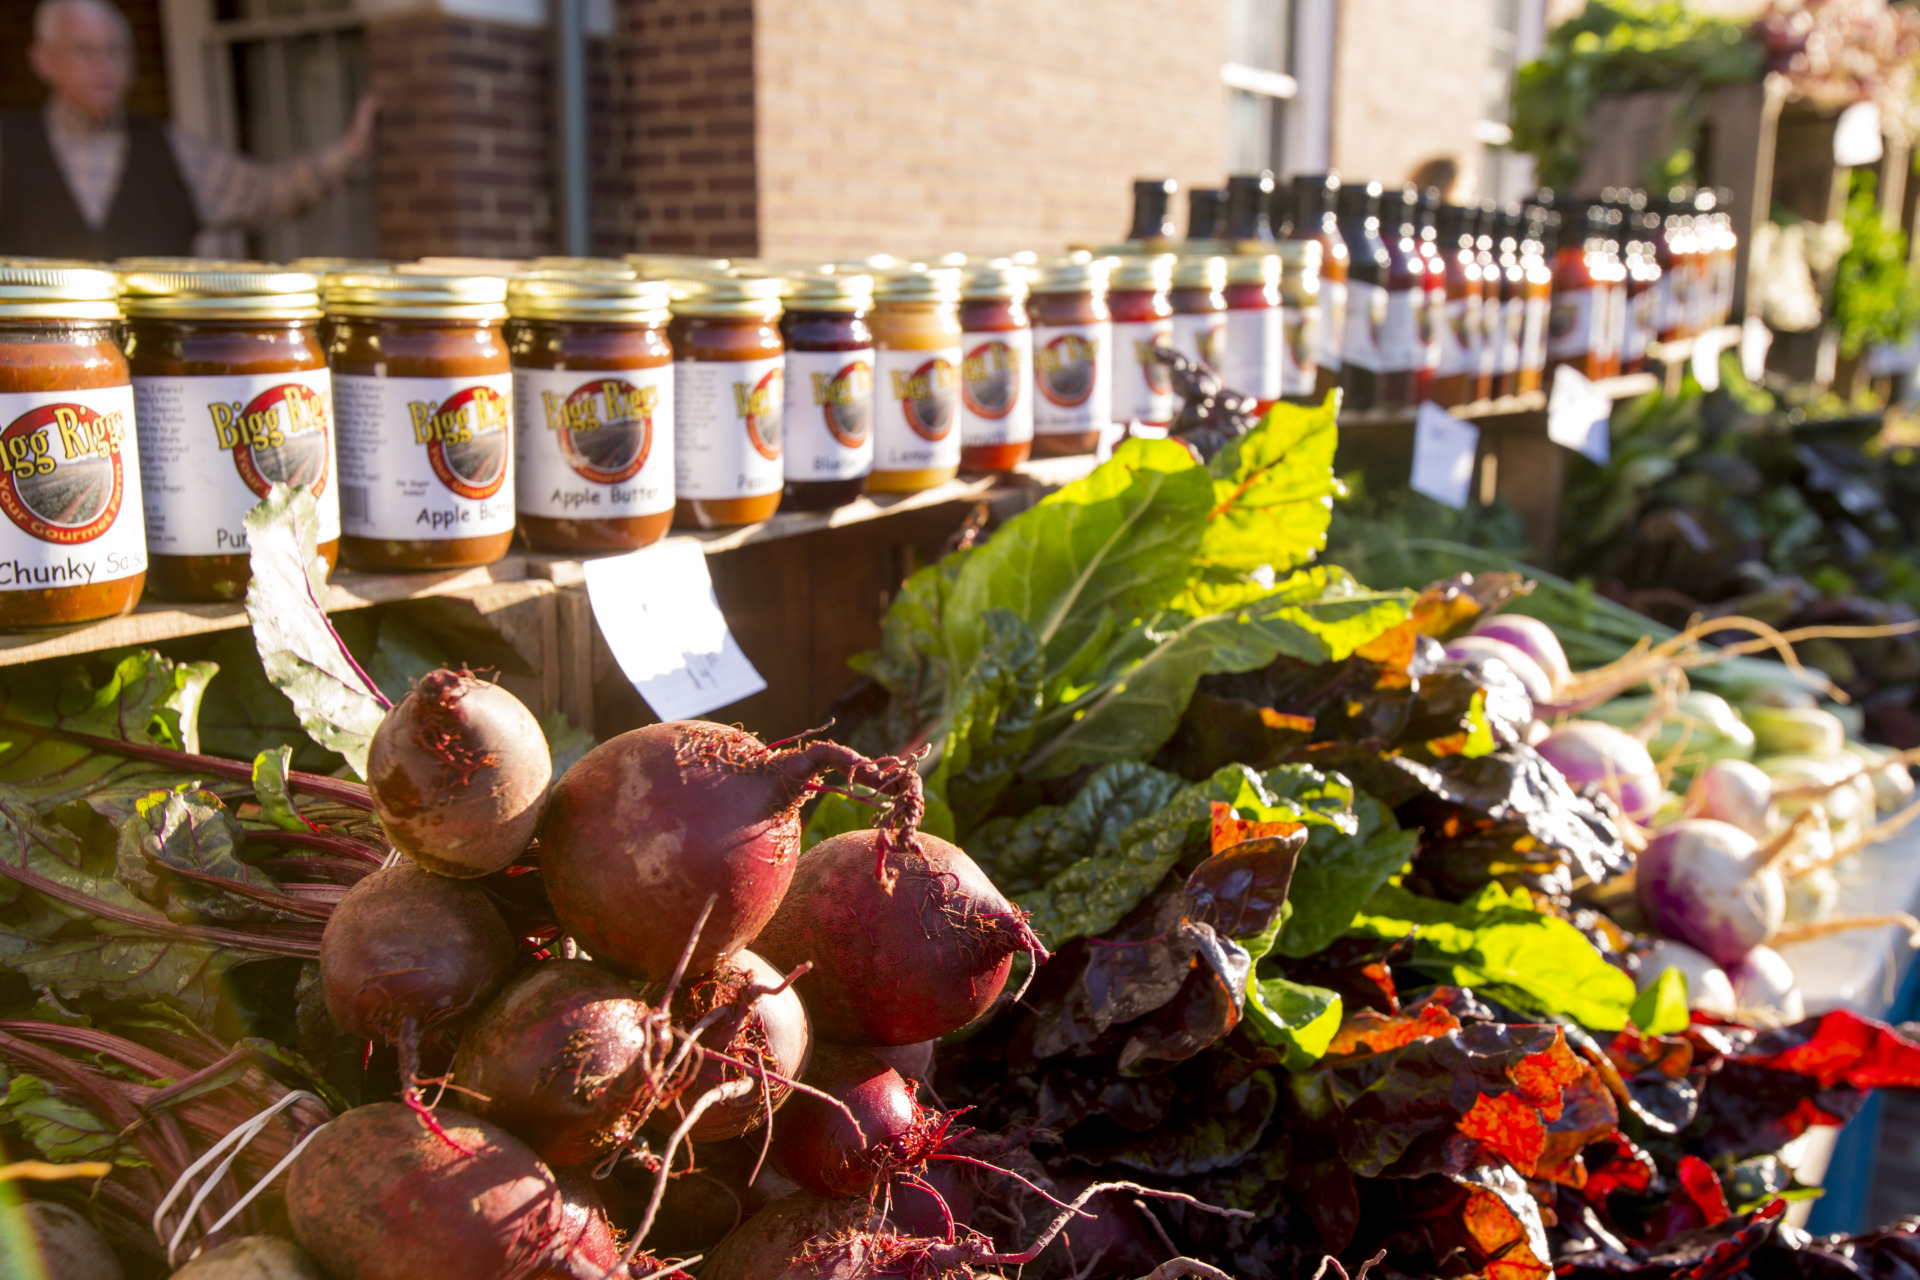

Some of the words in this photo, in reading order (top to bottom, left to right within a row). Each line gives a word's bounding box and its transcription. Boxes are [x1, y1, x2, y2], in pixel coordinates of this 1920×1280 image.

[207, 401, 285, 452] Bigg
[407, 400, 473, 447] Bigg
[542, 390, 600, 434] Bigg
[602, 381, 659, 422] Riggs
[0, 424, 57, 480] igg
[53, 405, 126, 459] Riggs
[0, 478, 28, 521] Your
[31, 513, 114, 542] Gourmet
[109, 463, 122, 515] Farm
[416, 505, 470, 530] Apple
[550, 488, 600, 509] Apple
[0, 557, 96, 585] Chunky
